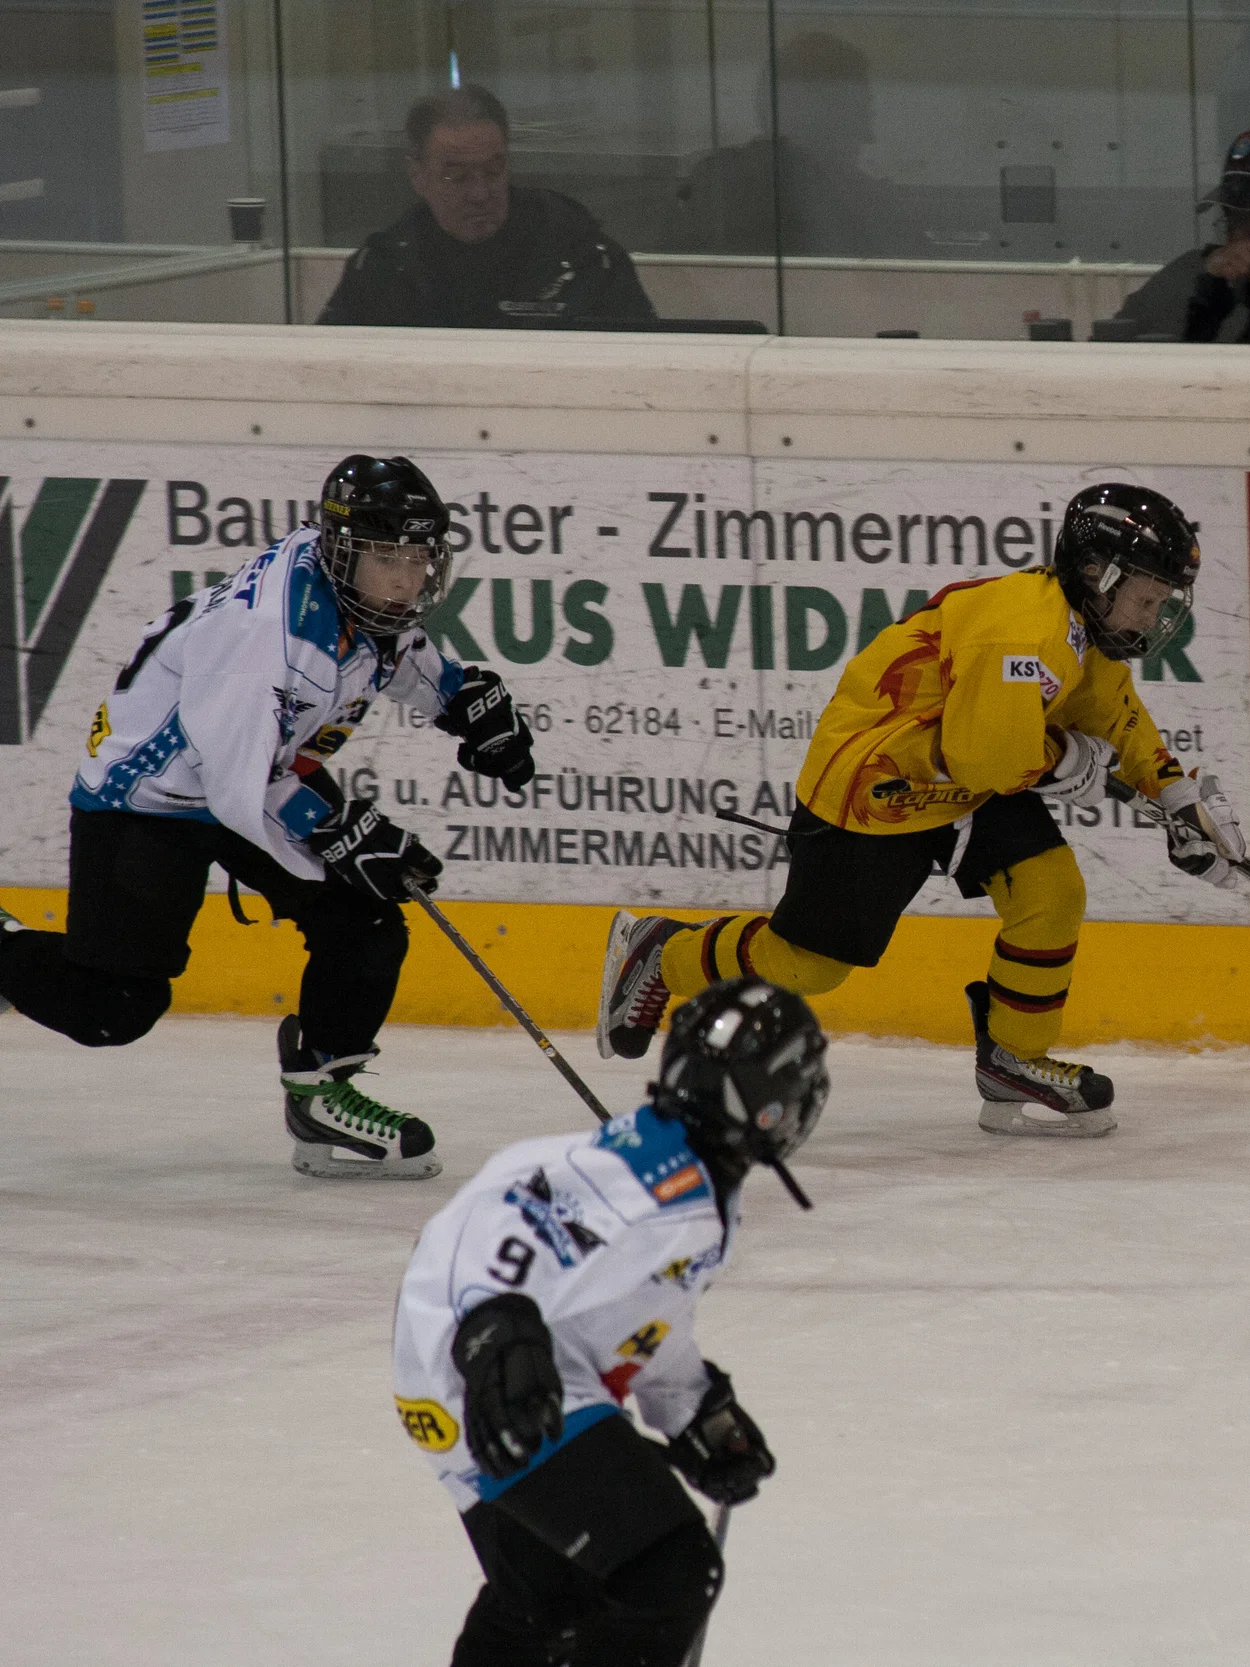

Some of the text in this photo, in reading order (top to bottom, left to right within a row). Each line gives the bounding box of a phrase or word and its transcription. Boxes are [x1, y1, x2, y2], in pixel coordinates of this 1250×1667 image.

[584, 704, 683, 737] 62184
[1158, 724, 1204, 753] net
[440, 767, 739, 815] AUSFÜHRUNG
[320, 806, 385, 864] BAUER
[444, 823, 792, 872] ZIMMERMANNSA
[488, 1236, 537, 1288] 9
